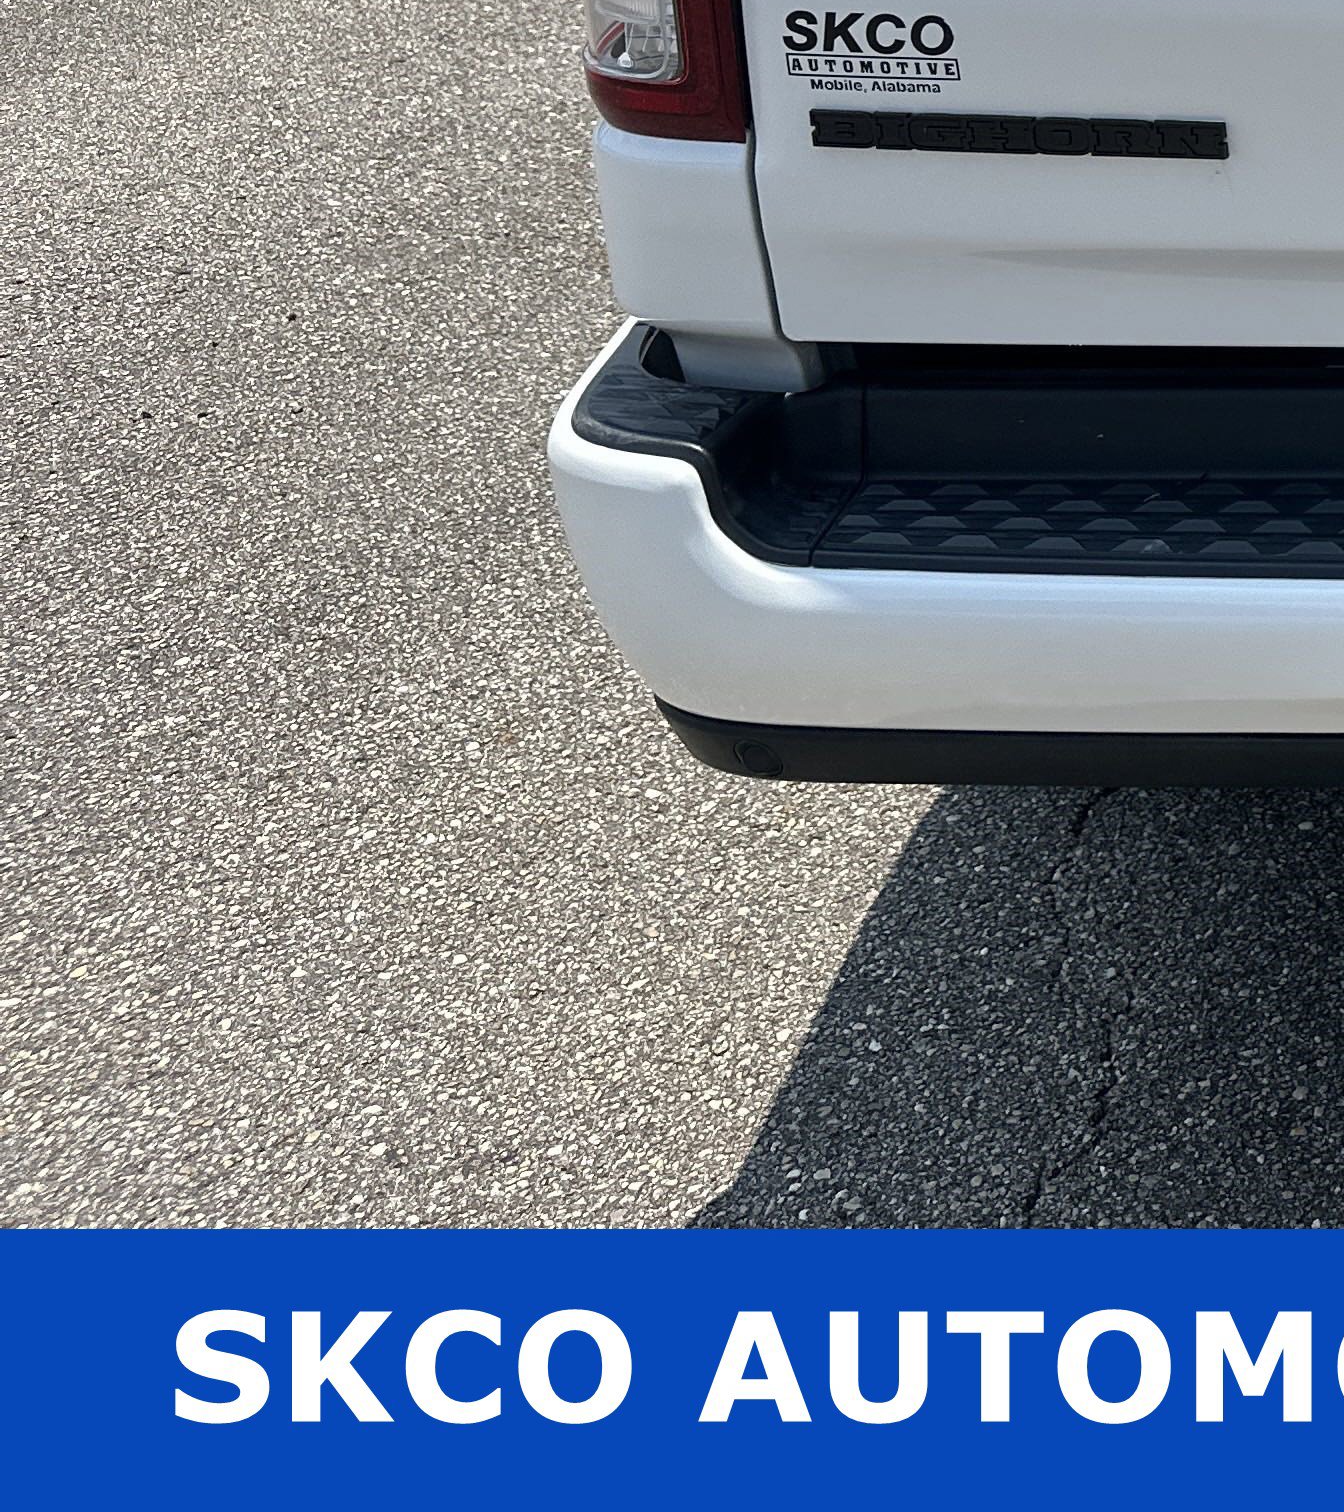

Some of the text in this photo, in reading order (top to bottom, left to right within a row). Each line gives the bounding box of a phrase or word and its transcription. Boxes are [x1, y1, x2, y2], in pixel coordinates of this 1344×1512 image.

[782, 9, 955, 56] SKCO
[791, 56, 956, 77] AUTOMOTIVE
[810, 78, 942, 94] Mobile, Alabama
[809, 108, 1230, 160] BIGHORN
